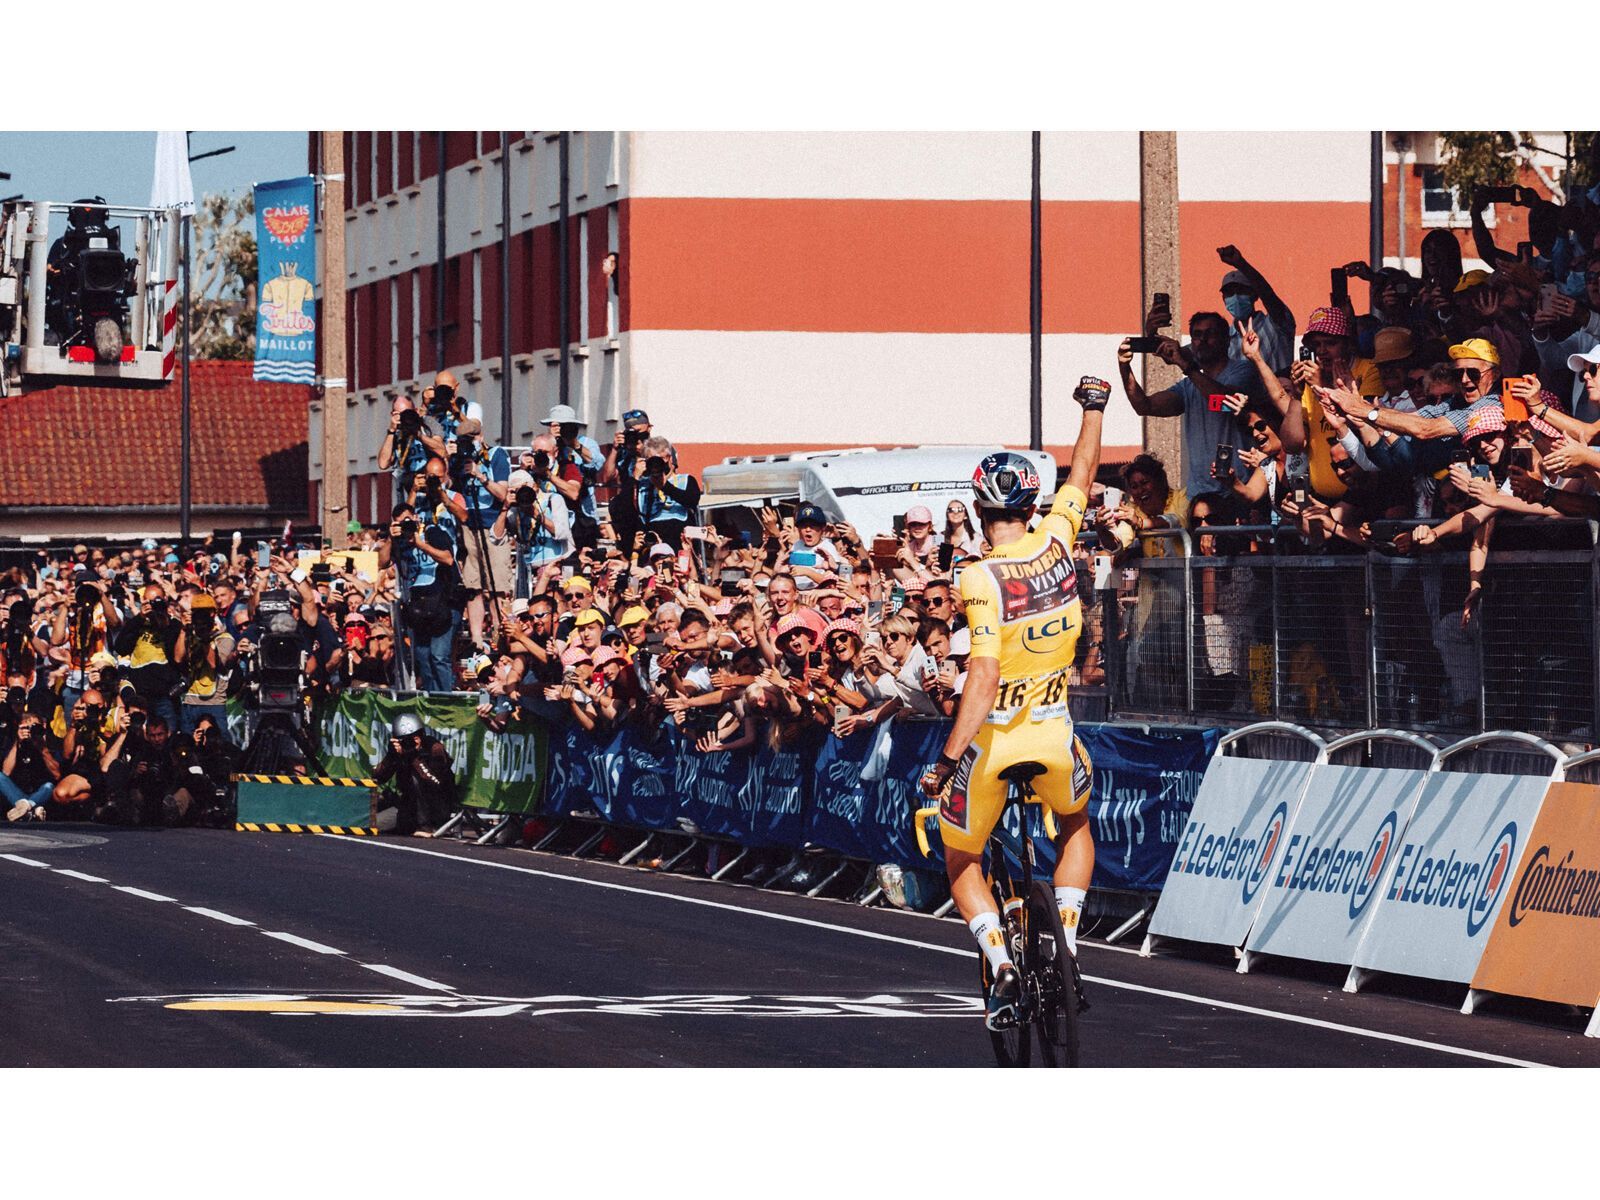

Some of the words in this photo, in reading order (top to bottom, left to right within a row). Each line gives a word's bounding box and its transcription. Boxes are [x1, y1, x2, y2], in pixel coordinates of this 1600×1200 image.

[262, 204, 310, 218] CALAIS
[270, 235, 305, 244] PLAGE
[259, 338, 313, 351] MAILLOT
[861, 486, 888, 495] OFFICIAL
[889, 483, 911, 493] STORE
[1000, 542, 1062, 580] JUMBO
[1029, 558, 1073, 592] VISMA
[1027, 616, 1075, 641] LCL
[995, 682, 1027, 711] 16
[953, 753, 972, 791] VISMA
[1172, 822, 1256, 881] E.Leclerc
[1274, 834, 1364, 895] E.Leclerc
[1386, 843, 1481, 910] E.Leclerc
